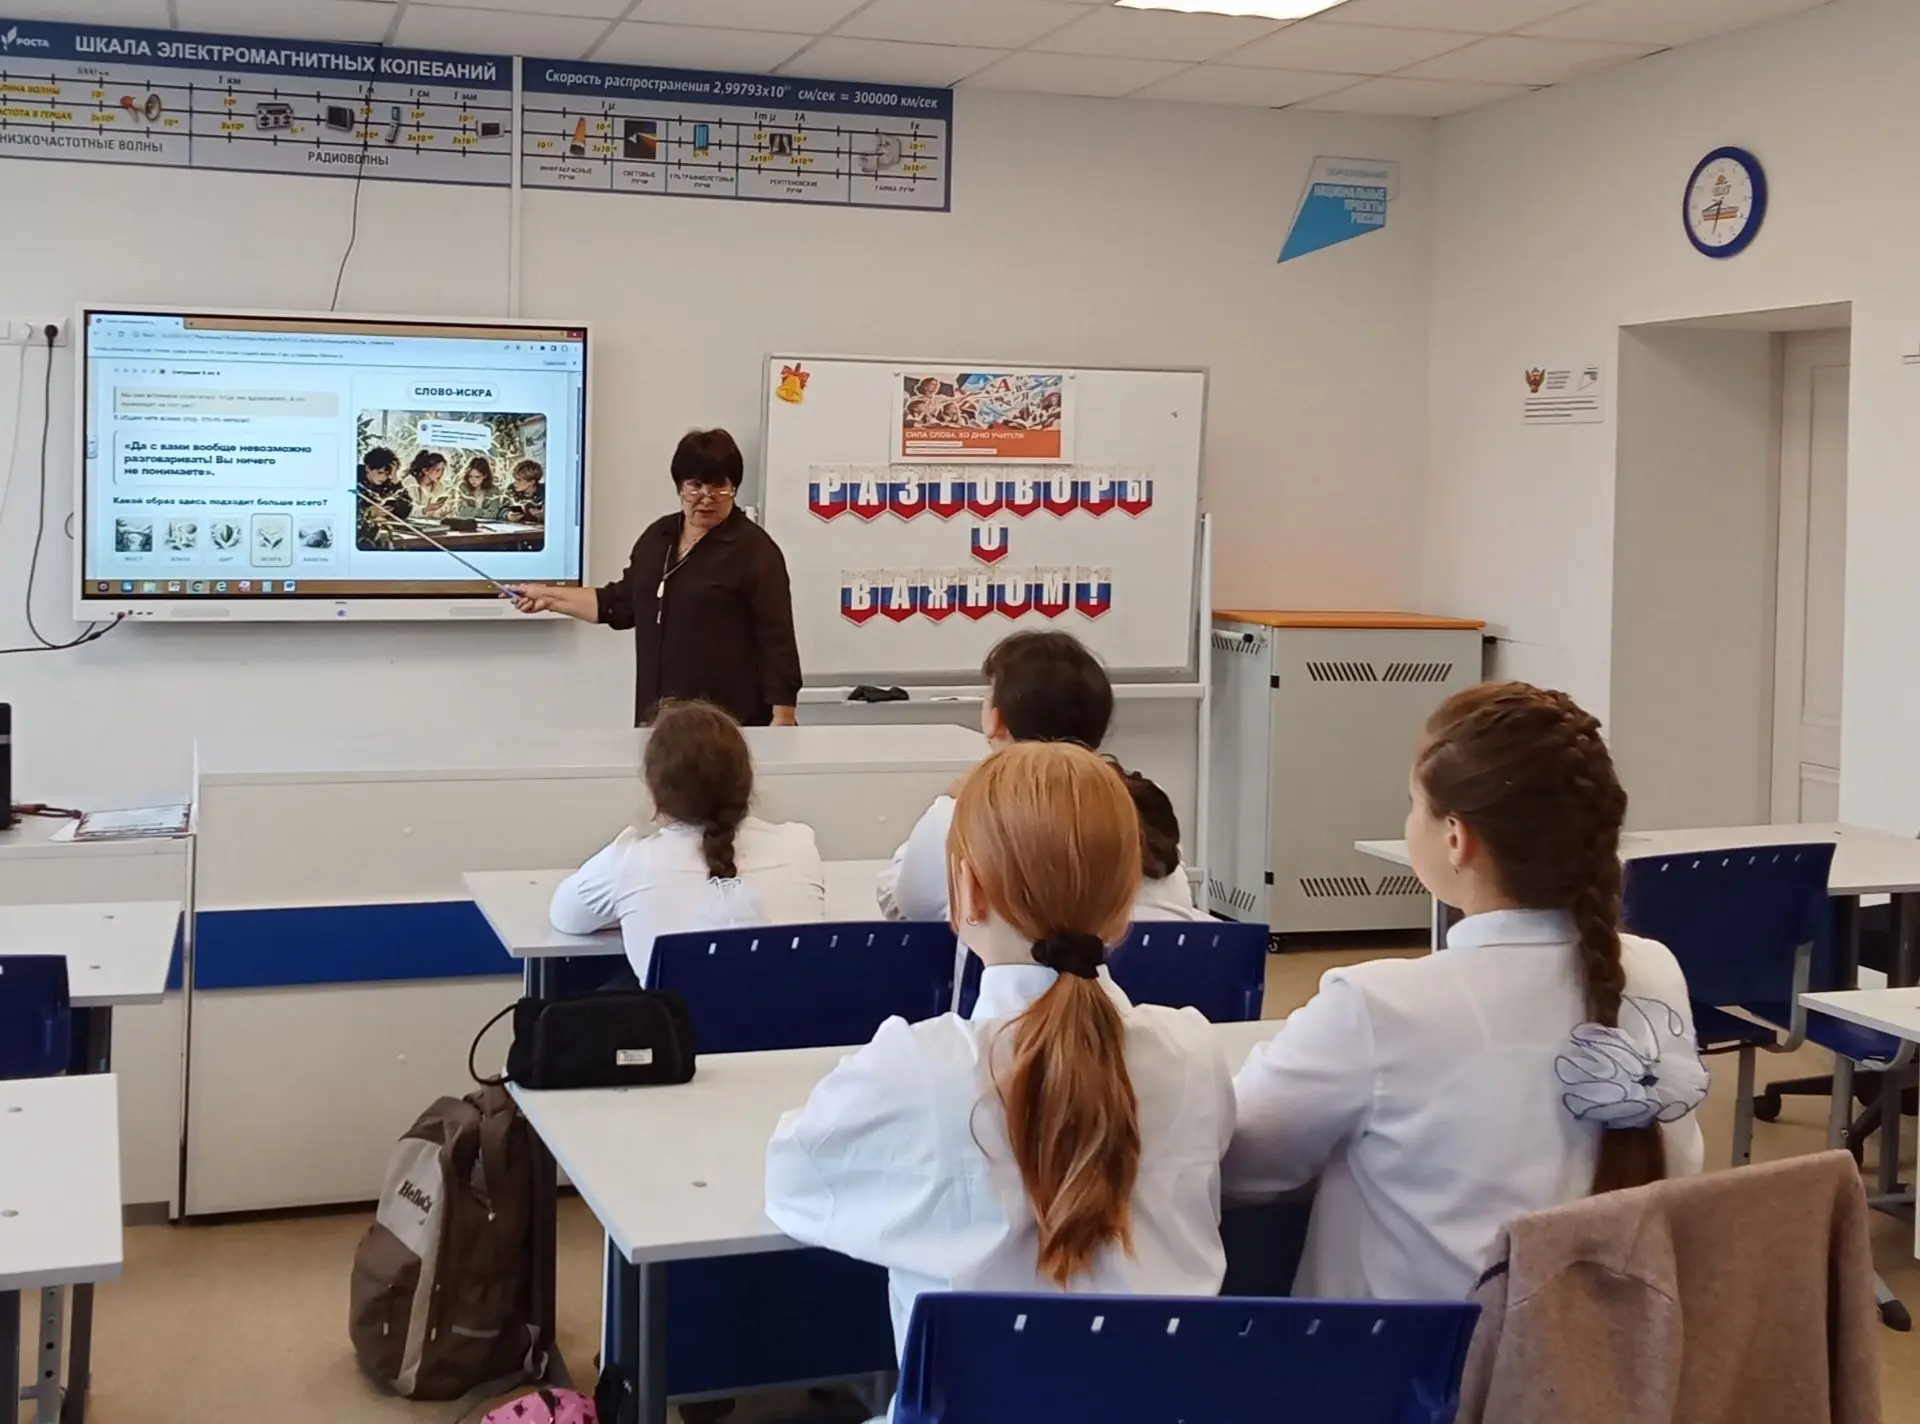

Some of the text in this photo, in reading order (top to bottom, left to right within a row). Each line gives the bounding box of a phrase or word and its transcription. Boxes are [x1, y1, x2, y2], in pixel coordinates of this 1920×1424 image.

[16, 37, 50, 48] РОСТА
[75, 35, 497, 81] ШКАЛА ЭЛЕКТРОМАГНИТНЫХ КОЛЕБАНИЙ
[545, 69, 601, 86] Скорость
[604, 75, 711, 93] распространения
[798, 88, 836, 102] см/сек
[853, 91, 898, 106] 300000
[900, 94, 938, 108] км/сек
[0, 134, 163, 153] НИЗКОЧАСТОТНЫЕ ВОЛНЫ
[307, 151, 389, 165] РАДИОВОЛНЫ
[414, 387, 493, 398] СЛОВО-ИСКРА
[905, 431, 928, 439] СИЛА
[160, 443, 190, 451] вами
[192, 442, 237, 453] вообще
[239, 445, 312, 453] невозможно
[124, 455, 276, 466] разговаривать! Вы ничего
[818, 470, 1147, 507] РАЗГОВОРЫ
[113, 496, 328, 507] Какой образ здесь подходит больше всего?
